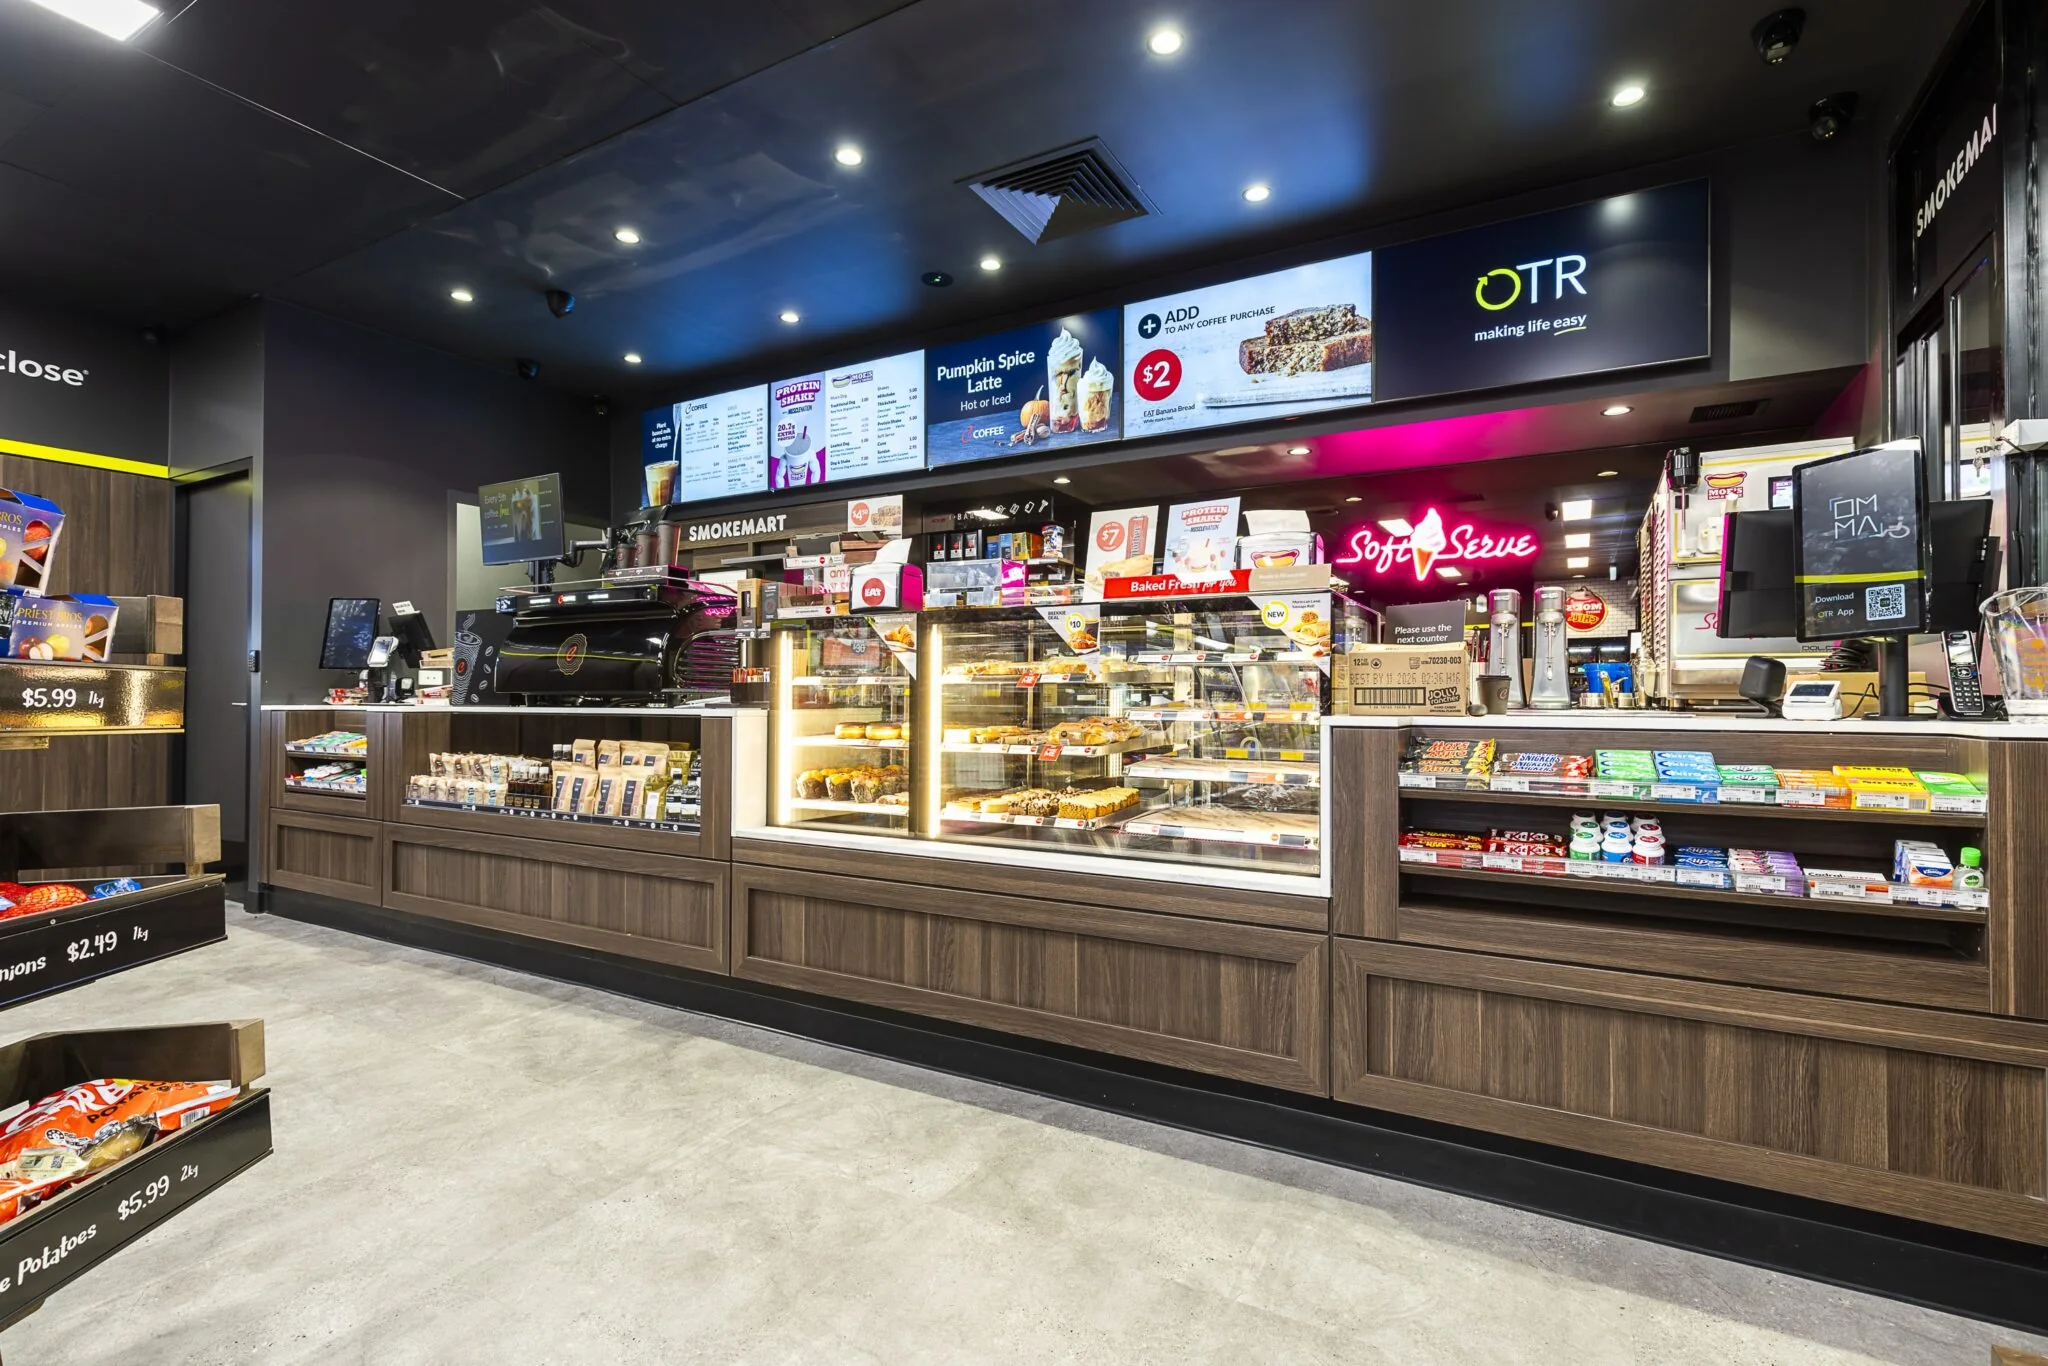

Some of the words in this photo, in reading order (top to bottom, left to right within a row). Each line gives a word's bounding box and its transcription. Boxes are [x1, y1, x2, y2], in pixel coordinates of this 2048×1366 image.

[1475, 255, 1587, 310] OTR
[1165, 306, 1200, 324] ADD
[1165, 327, 1176, 335] TO
[1177, 322, 1195, 333] ANY
[1197, 316, 1227, 328] COFFEE
[1230, 306, 1276, 322] PURCHASE
[1474, 325, 1525, 341] making
[1528, 319, 1550, 333] life
[1554, 315, 1587, 329] easy
[937, 358, 995, 382] Pumpkin
[998, 350, 1035, 371] Spice
[1143, 361, 1171, 388] $2
[776, 381, 820, 399] PROTEIN
[967, 377, 1002, 393] Latte
[782, 393, 815, 406] SHAKE
[960, 400, 978, 412] Hot
[980, 399, 989, 407] or
[992, 393, 1011, 406] Iced
[1156, 406, 1177, 416] Banana
[1178, 404, 1195, 412] Bread
[777, 430, 796, 438] EXTRA
[973, 426, 1005, 440] COFFEE
[1182, 506, 1229, 520] PROTEIN
[1186, 515, 1223, 526] SHAKE
[689, 514, 787, 542] SMOKEMART
[1102, 529, 1121, 549] $7
[1336, 531, 1412, 574] Soft
[1437, 524, 1537, 560] Serve
[864, 587, 882, 598] EAT
[1131, 580, 1166, 593] Baked
[1815, 592, 1855, 604] Download
[16, 607, 55, 620] PRIEST
[56, 611, 82, 622] BROS
[1267, 611, 1285, 619] NEW
[1818, 610, 1834, 618] OTR
[1837, 608, 1855, 617] App
[1070, 621, 1082, 629] $10
[1395, 626, 1420, 635] Please
[1438, 624, 1453, 632] the
[1397, 635, 1415, 644] next
[1416, 634, 1449, 643] counter
[1428, 657, 1462, 665] 70230-003
[1350, 673, 1370, 685] BEST
[1374, 673, 1384, 685] BY
[22, 687, 77, 708] $5.99
[89, 691, 105, 708] 1kg
[1428, 687, 1458, 701] JOLLY
[1520, 755, 1561, 763] SNICKERS
[1678, 857, 1722, 866] eclipse
[67, 931, 118, 963] $2.49
[133, 926, 149, 941] 1kg
[180, 1165, 199, 1182] 2kg
[118, 1175, 170, 1221] $5.99
[18, 1224, 97, 1286] Potatoes
